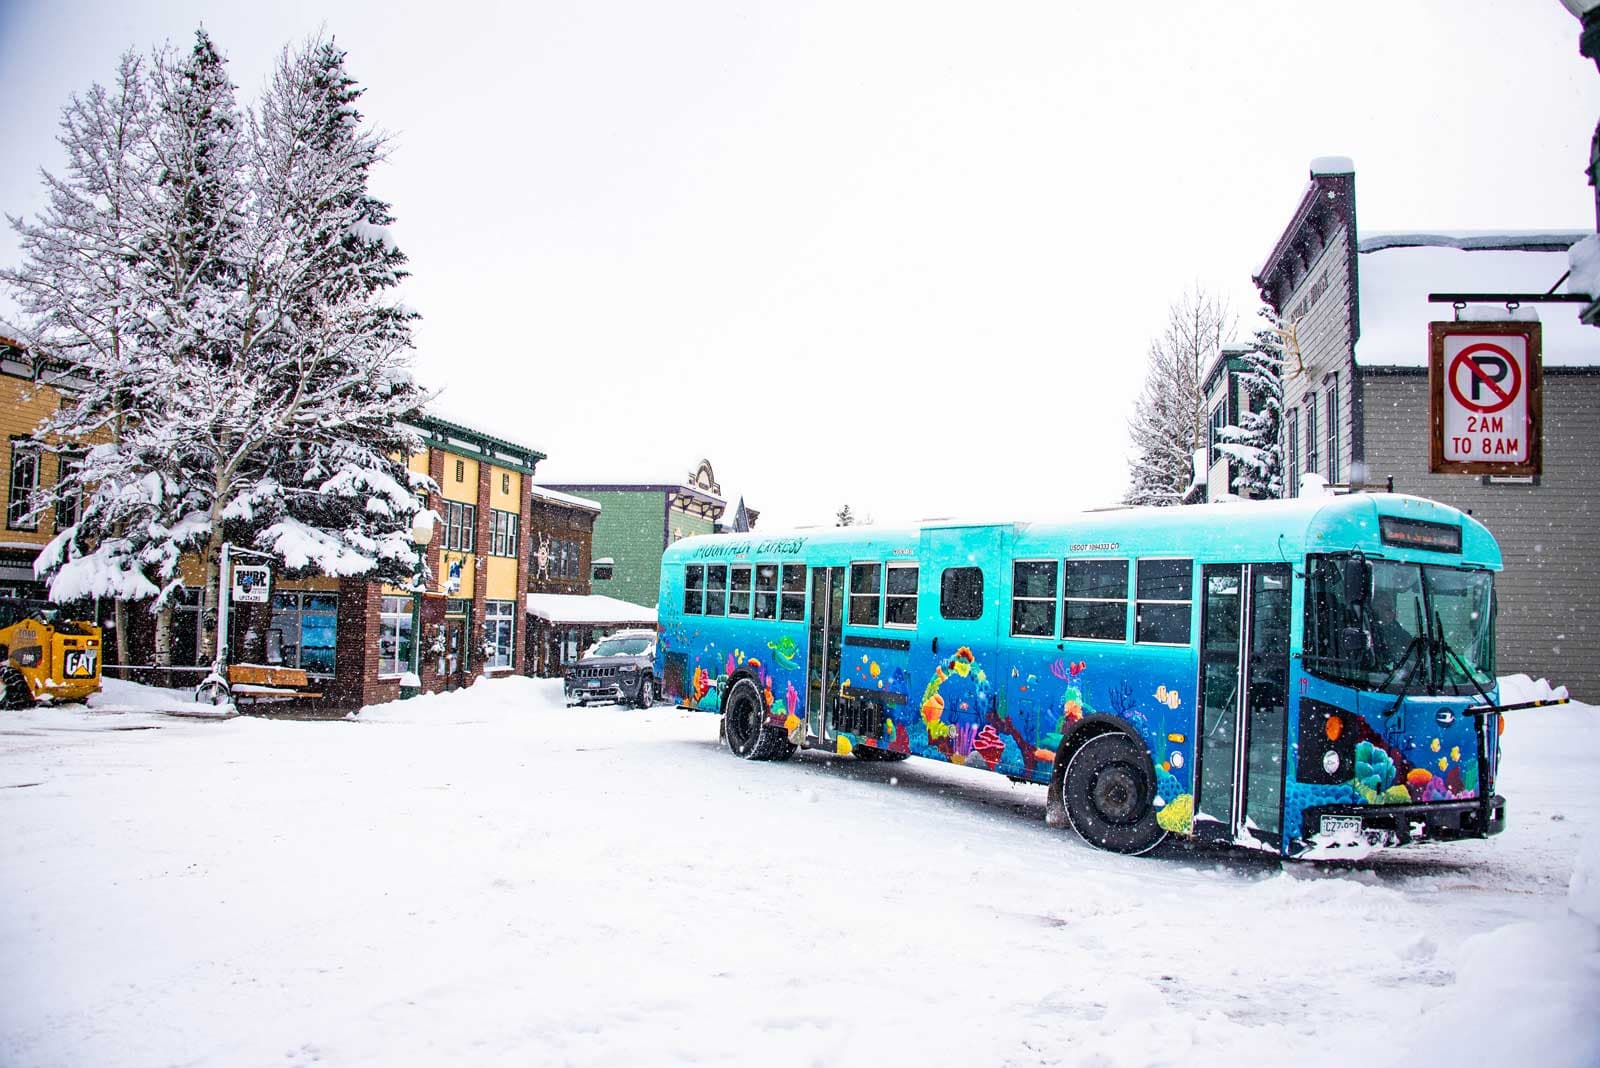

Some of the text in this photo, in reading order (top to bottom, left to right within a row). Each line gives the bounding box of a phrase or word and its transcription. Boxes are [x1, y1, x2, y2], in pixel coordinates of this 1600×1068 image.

[1467, 416, 1503, 432] 2AM
[1452, 438, 1518, 454] TO 8AM
[66, 653, 95, 676] CAT
